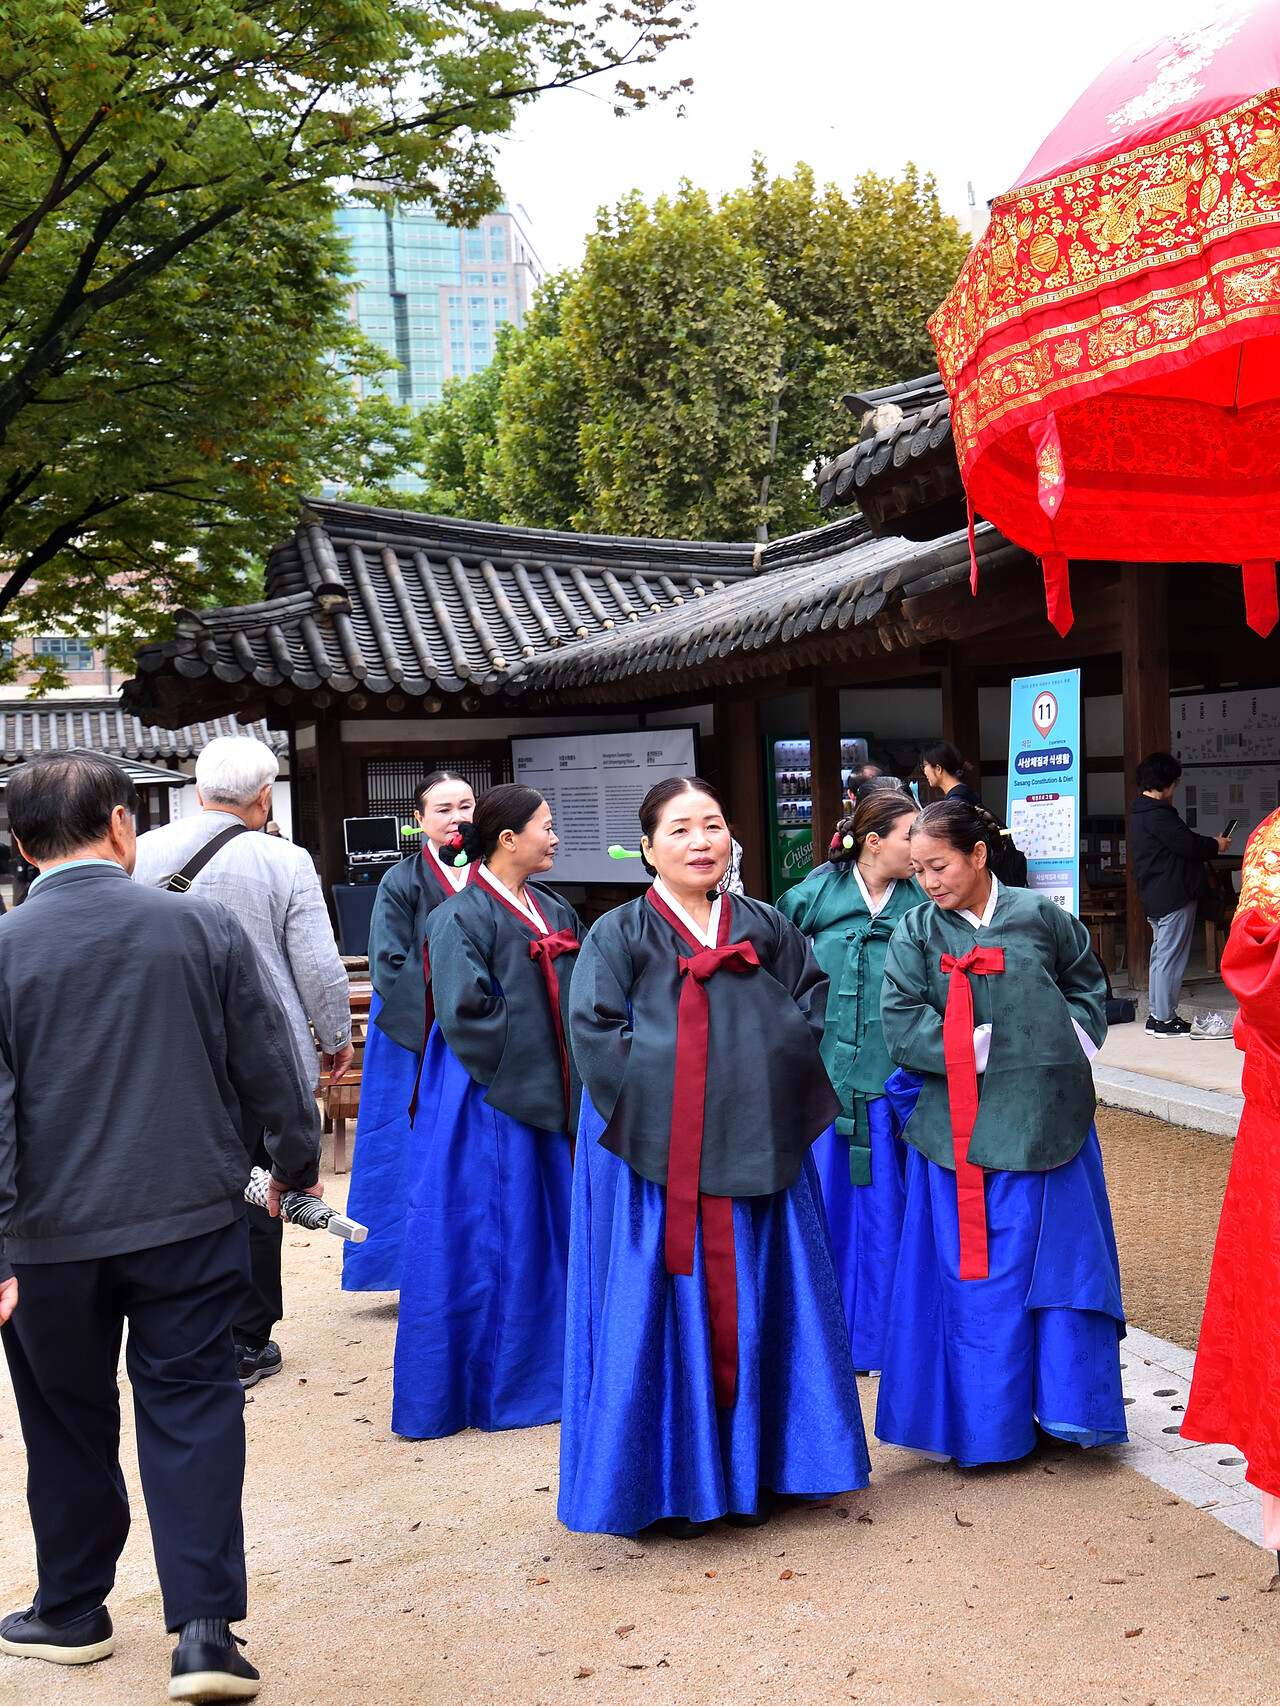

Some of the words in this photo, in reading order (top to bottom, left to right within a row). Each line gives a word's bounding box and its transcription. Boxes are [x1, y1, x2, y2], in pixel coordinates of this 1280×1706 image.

[1038, 703, 1051, 721] 11
[1018, 755, 1049, 769] 사상체질과
[1049, 753, 1070, 766] 식생활
[1014, 780, 1031, 788] Sasang
[1032, 776, 1058, 786] Constitution
[798, 852, 814, 869] Cide
